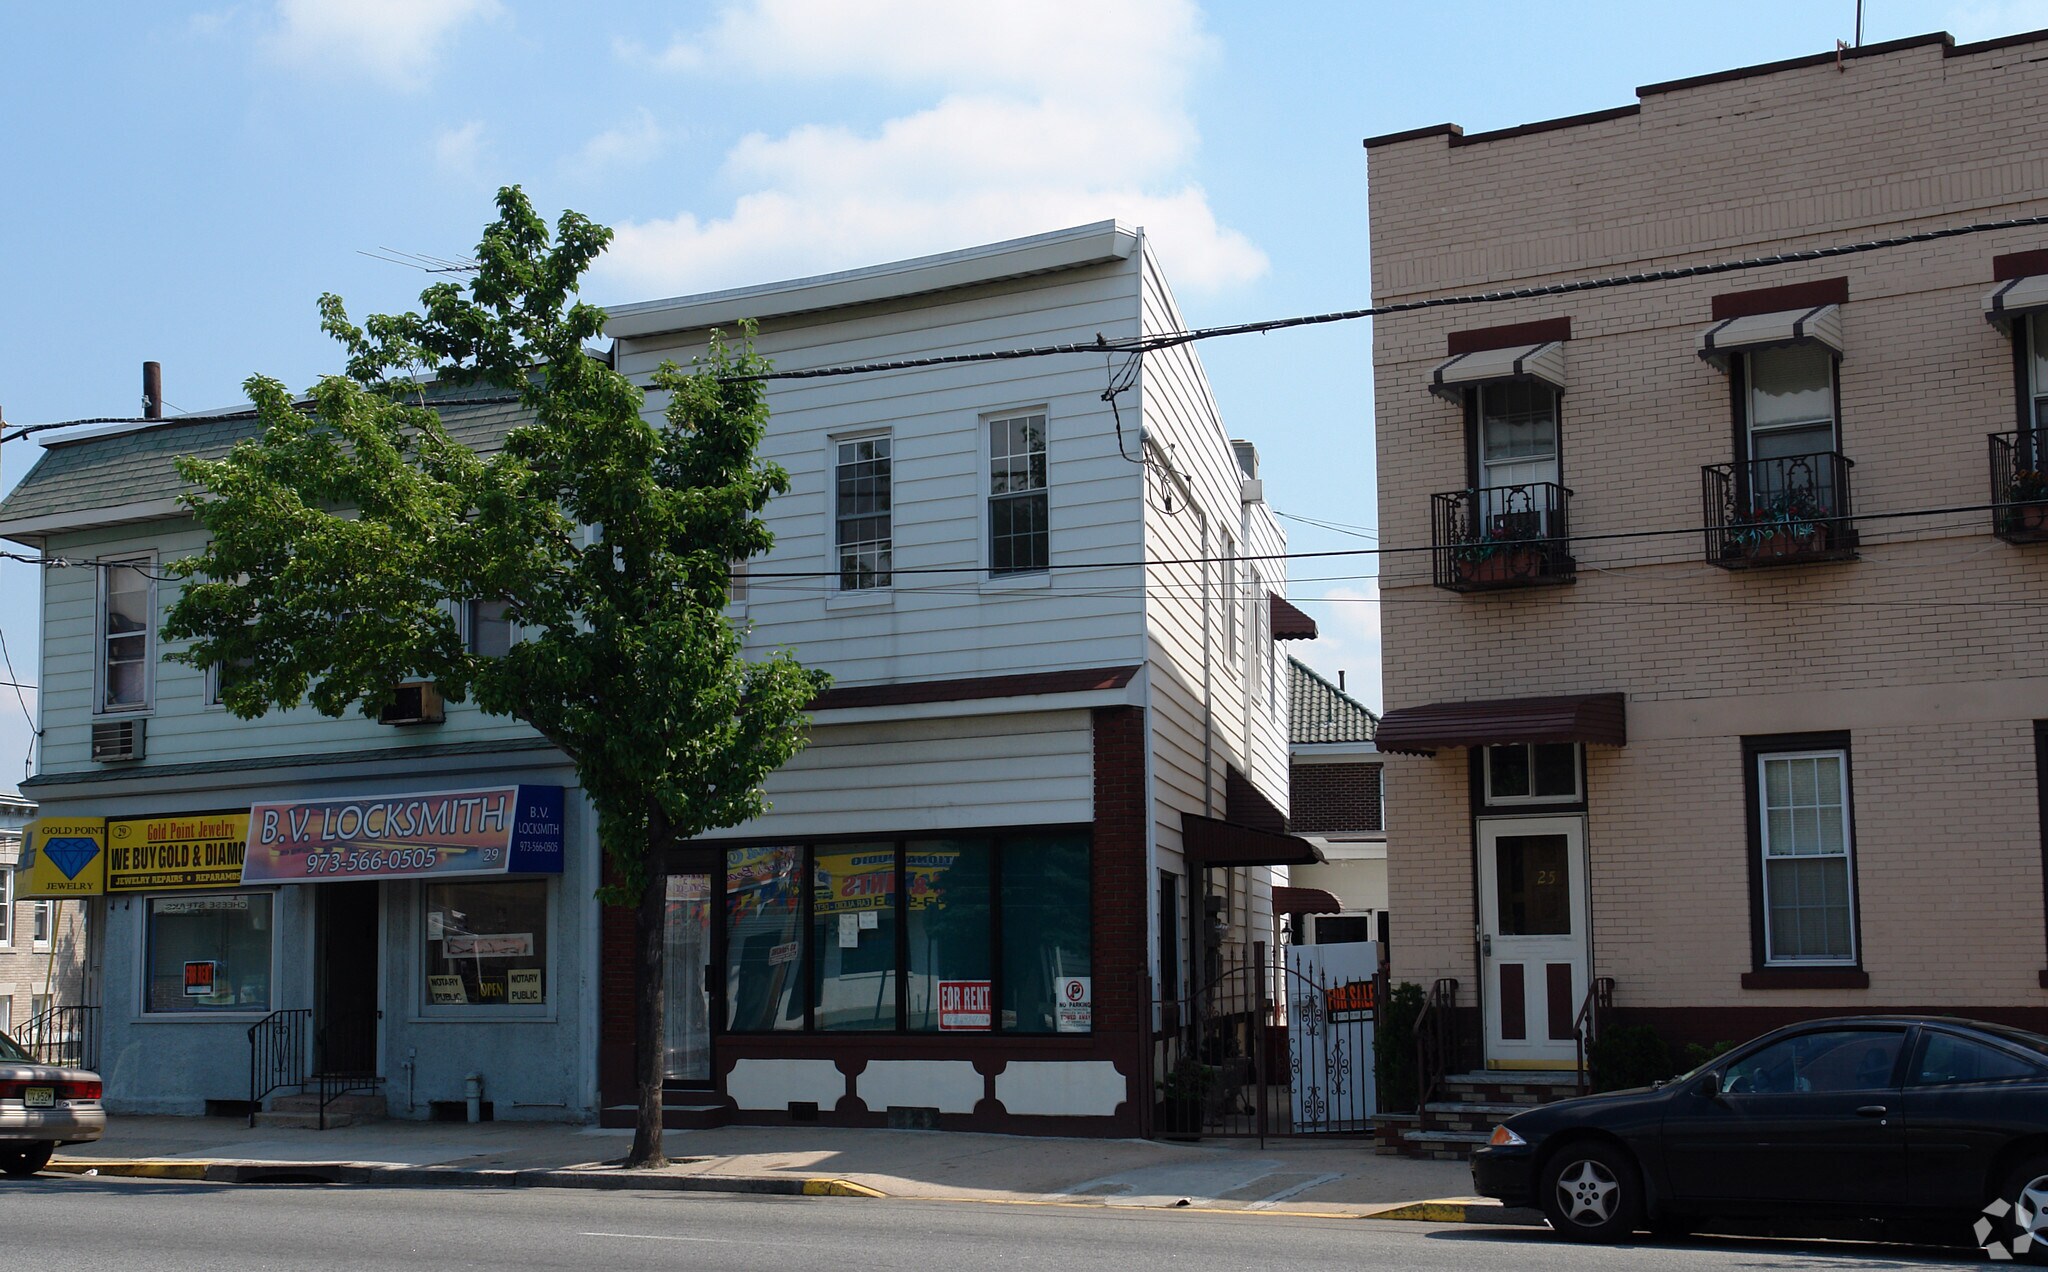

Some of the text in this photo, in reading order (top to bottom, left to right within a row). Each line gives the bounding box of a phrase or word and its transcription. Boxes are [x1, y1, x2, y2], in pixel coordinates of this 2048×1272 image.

[529, 806, 549, 819] B.V.
[260, 796, 505, 845] B.V. LOCKSMITH
[42, 826, 105, 835] GOLD POINT
[117, 827, 127, 837] 29
[147, 819, 235, 841] Gold Point Jewelry
[518, 822, 560, 835] LOCKSMITH
[519, 840, 559, 852] 973-566-0505
[111, 847, 130, 871] WE
[132, 846, 157, 869] BUY
[159, 844, 189, 869] GOLD
[193, 844, 202, 867] &
[306, 847, 437, 874] 973-566-0505
[483, 848, 499, 862] 29
[115, 875, 150, 886] JEWELRY
[151, 874, 184, 885] REPAIRS
[1537, 870, 1556, 885] 25
[46, 882, 94, 890] JEWELRY
[430, 978, 459, 986] NOTARY
[511, 974, 538, 983] NOTARY
[480, 982, 504, 997] OPEN
[511, 990, 538, 1000] PUBLIC
[435, 992, 462, 1001] PUBLIC
[941, 986, 991, 1011] FOR RENT
